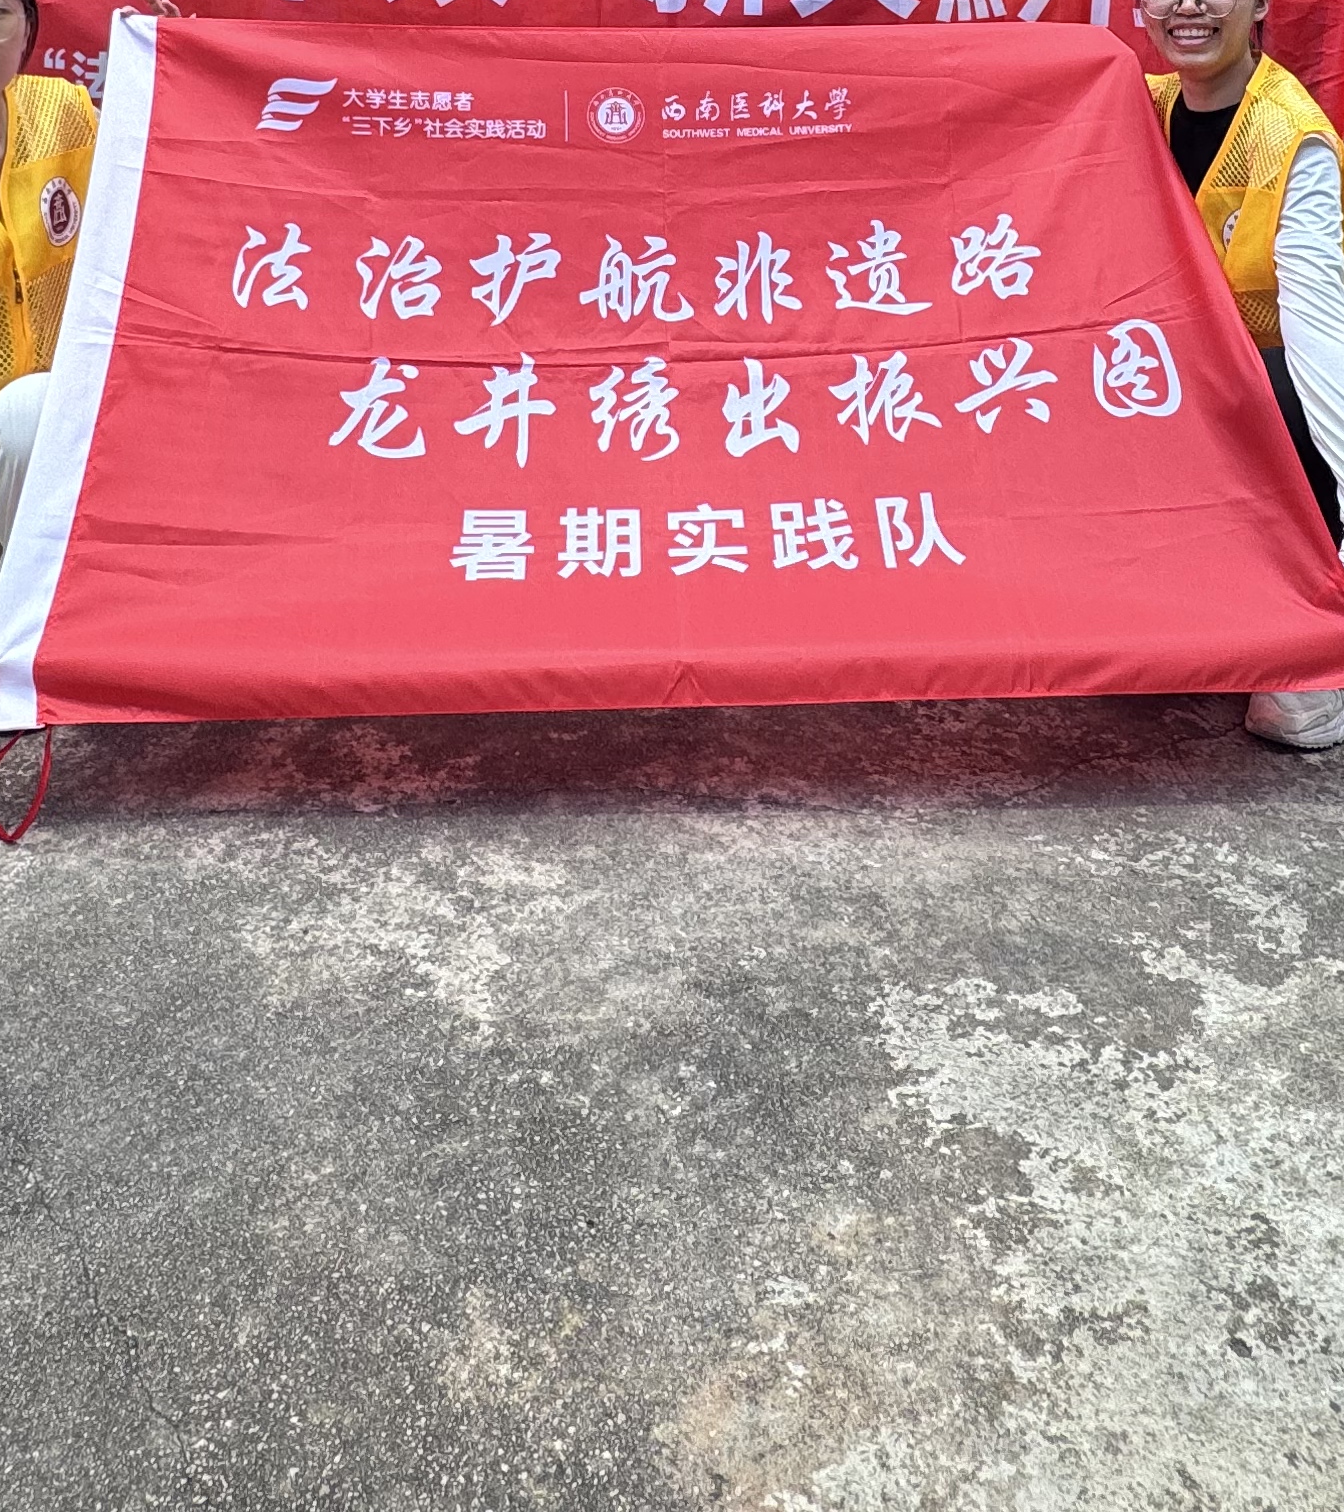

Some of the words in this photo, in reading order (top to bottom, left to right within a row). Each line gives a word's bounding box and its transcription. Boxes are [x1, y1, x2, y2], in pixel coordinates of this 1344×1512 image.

[343, 88, 475, 111] 大学生志愿者
[662, 127, 731, 139] SOUTHWEST
[736, 126, 784, 138] MEDICAL
[789, 123, 853, 136] UNIVERSITY
[231, 213, 1042, 328] 法治护航非遗路
[328, 318, 1183, 469] 龙井绣出振兴图
[449, 492, 967, 582] 暑期实践队
